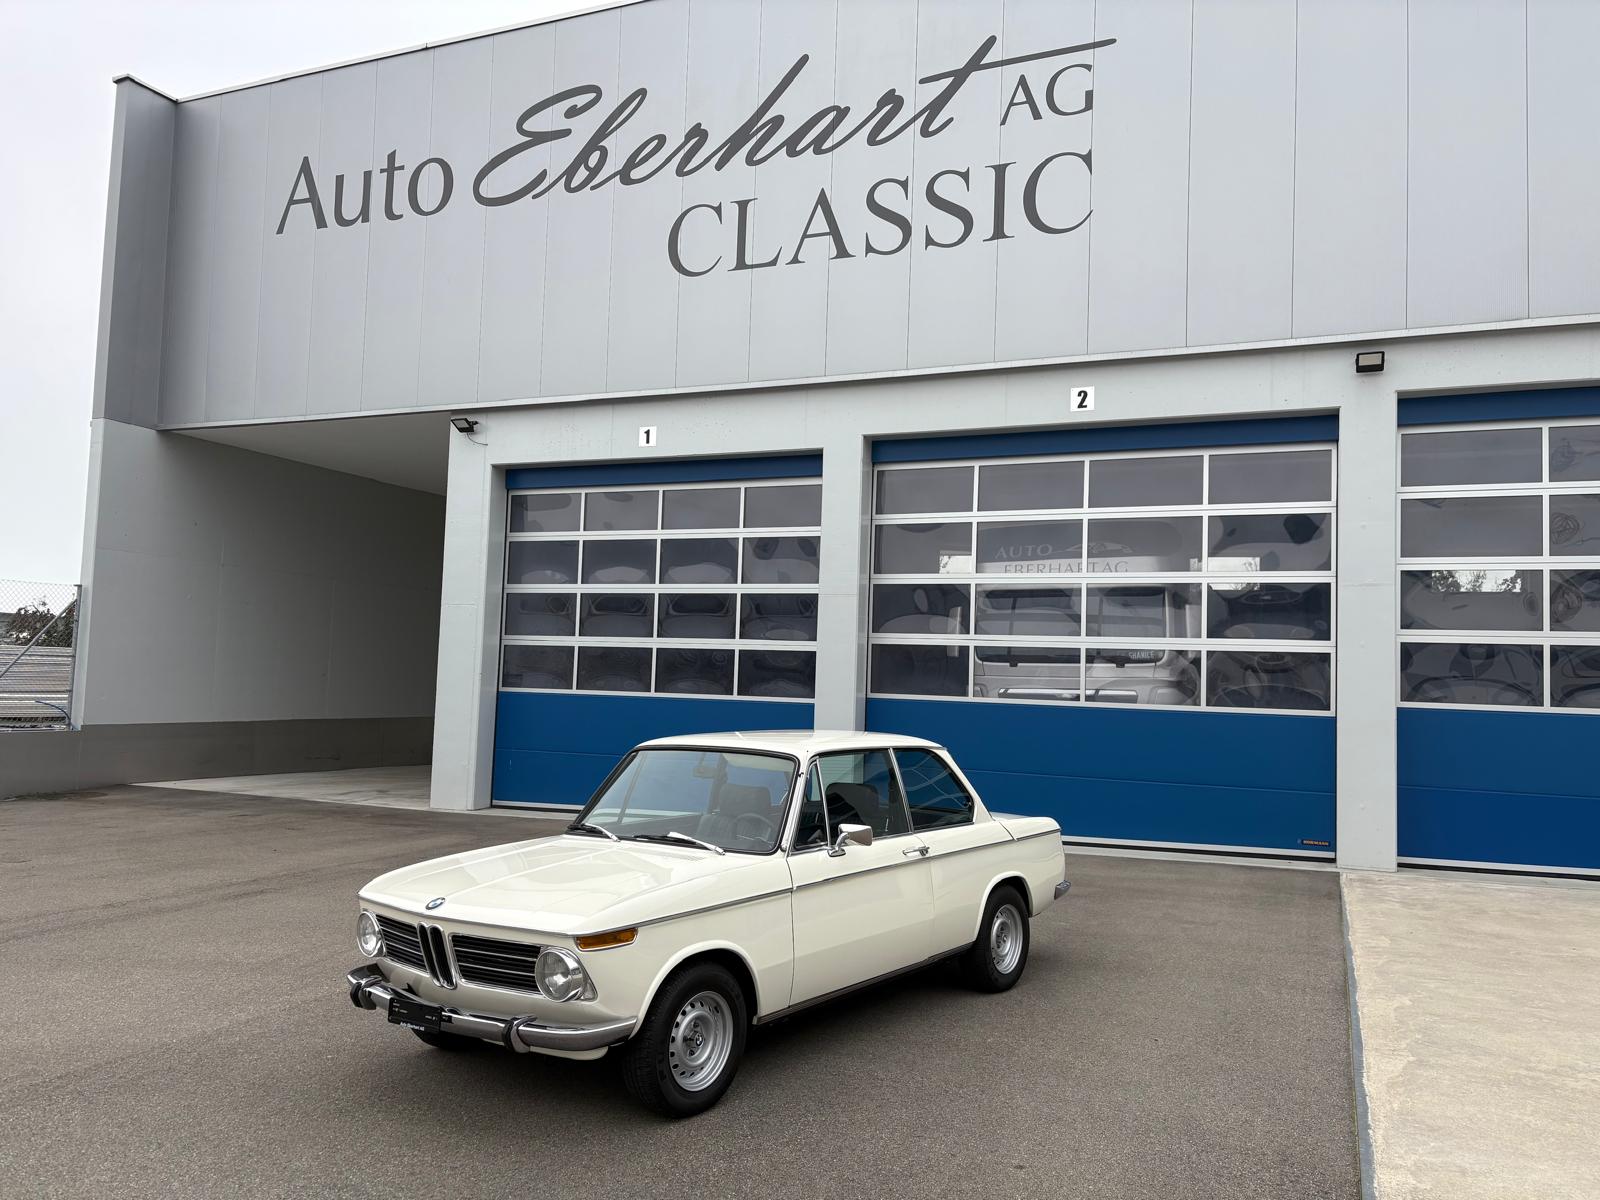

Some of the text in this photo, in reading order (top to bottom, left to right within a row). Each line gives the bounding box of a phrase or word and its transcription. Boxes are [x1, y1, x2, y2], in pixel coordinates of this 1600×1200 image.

[276, 35, 1117, 235] Auto Eberhart AG
[667, 150, 1094, 278] CLASSIC
[1077, 389, 1088, 409] 2
[644, 429, 651, 445] 1
[994, 543, 1053, 559] AUTO
